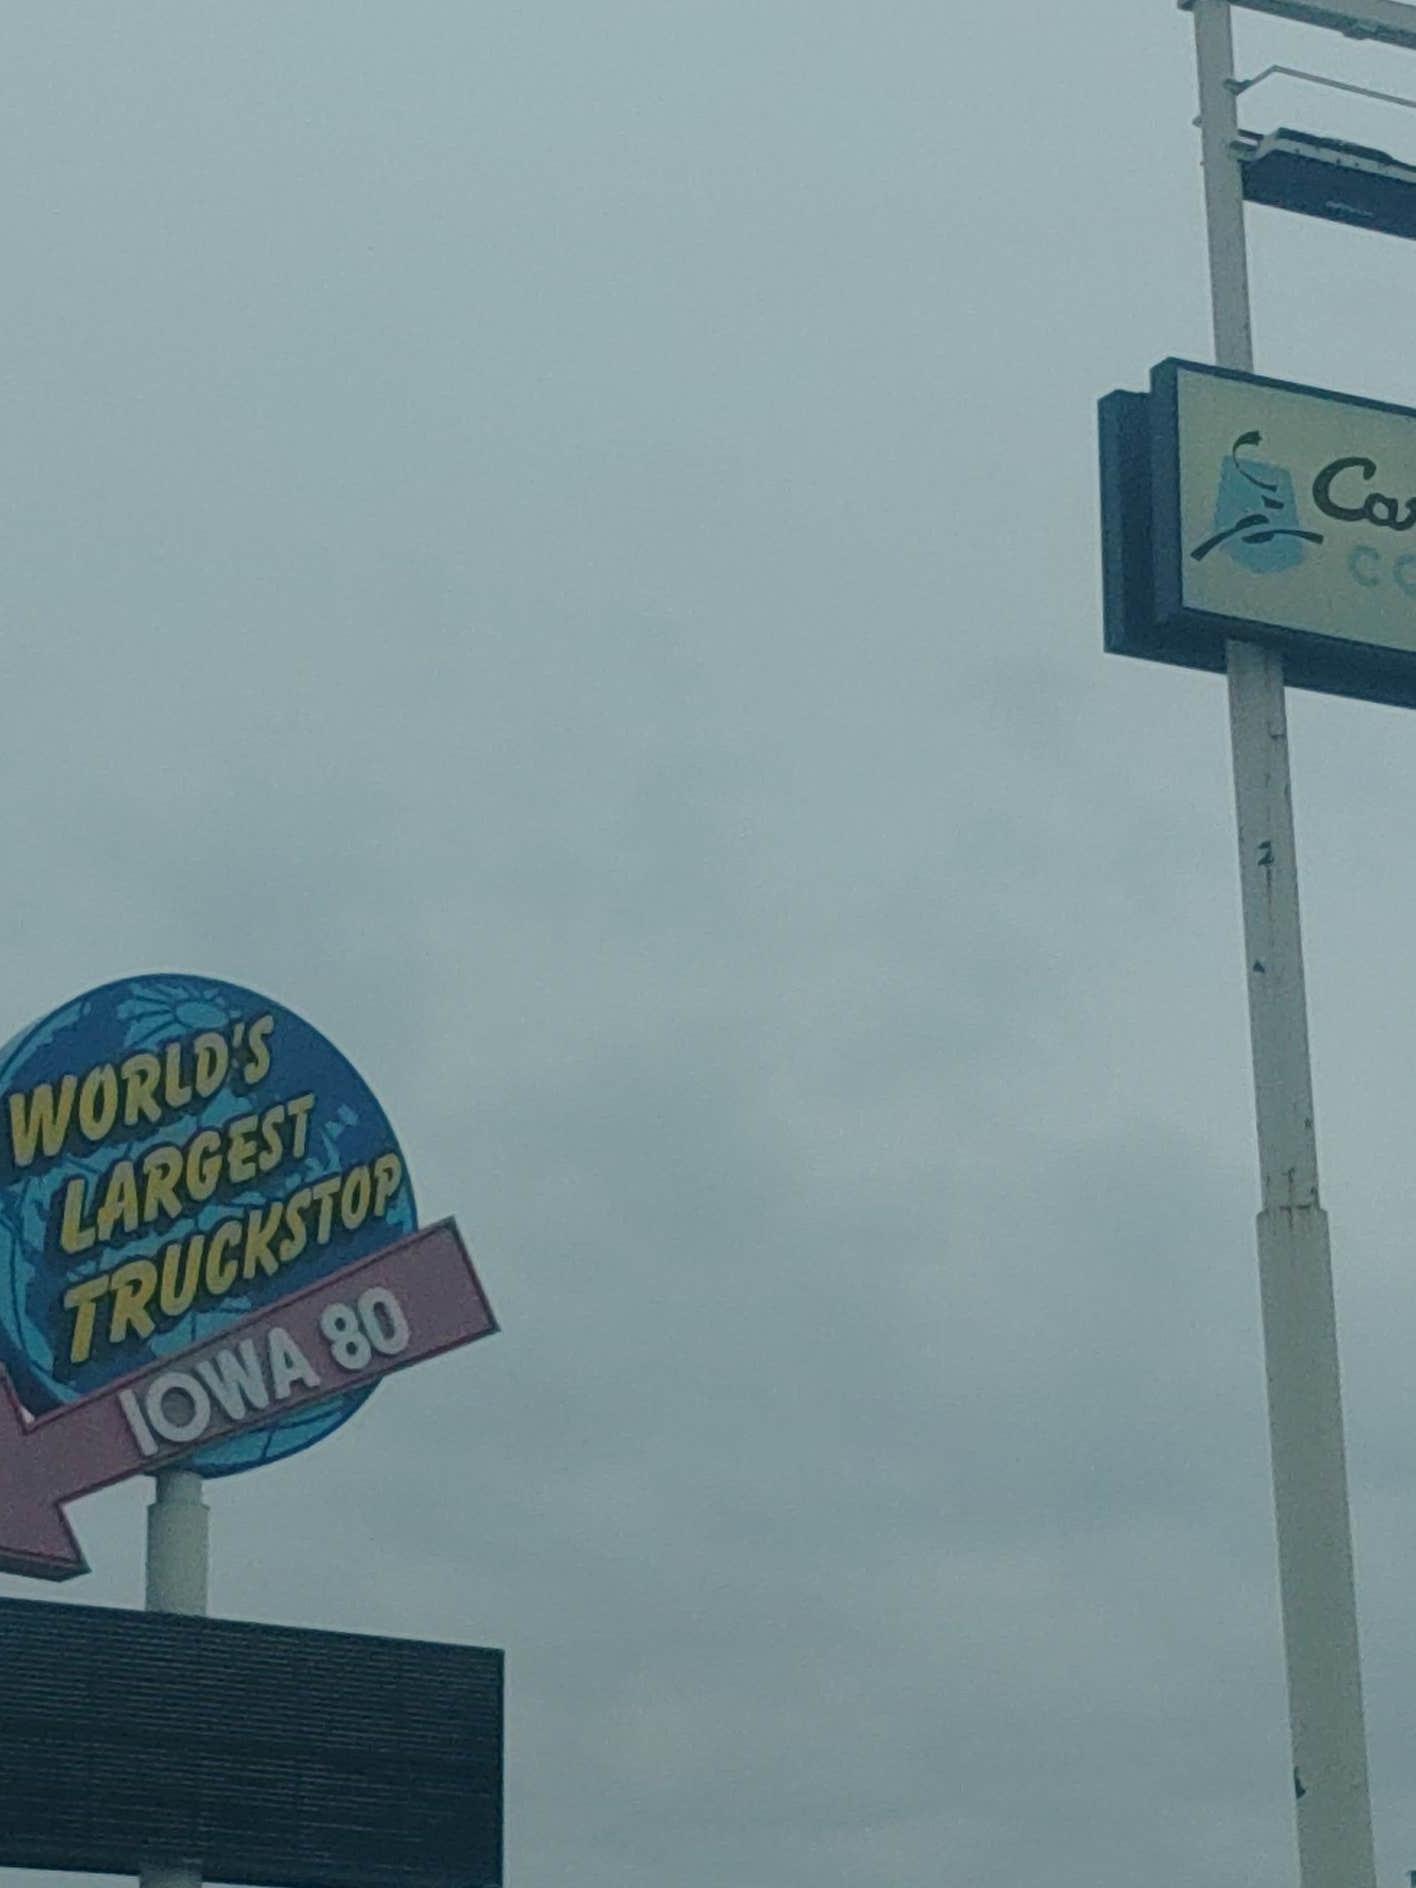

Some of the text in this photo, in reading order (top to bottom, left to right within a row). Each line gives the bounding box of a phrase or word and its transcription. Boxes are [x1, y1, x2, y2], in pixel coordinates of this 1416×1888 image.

[8, 1014, 275, 1169] WORLD'S
[59, 1093, 315, 1255] LARGEST
[63, 1152, 404, 1364] TRUCKSTOP
[117, 1285, 411, 1457] IOWA 80
